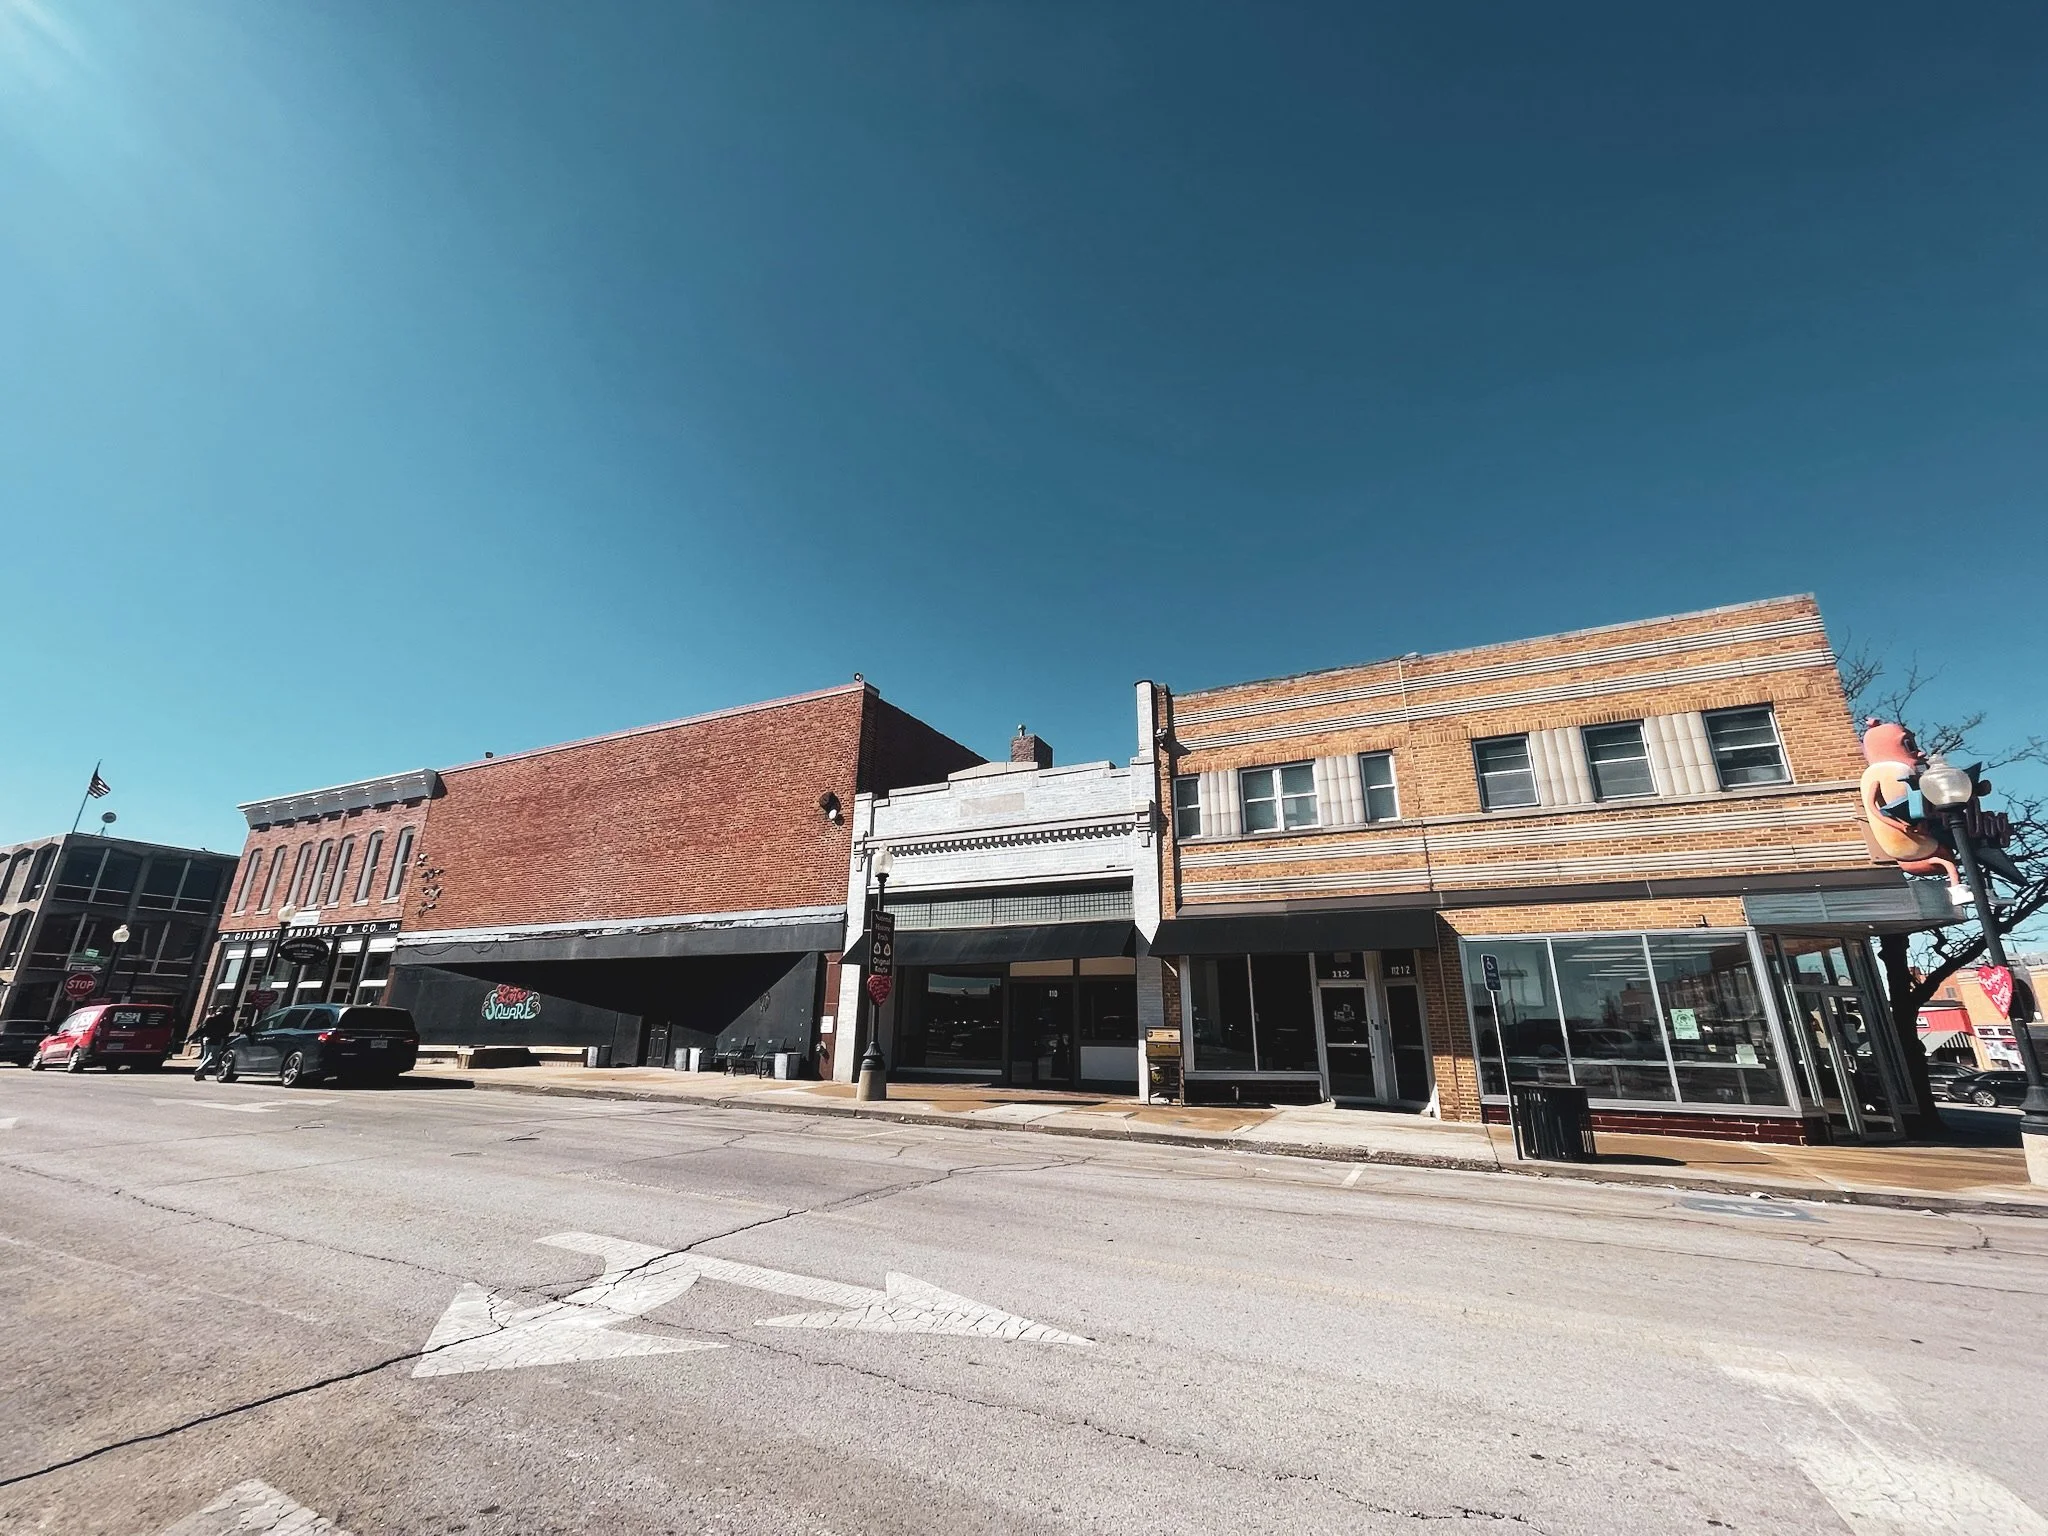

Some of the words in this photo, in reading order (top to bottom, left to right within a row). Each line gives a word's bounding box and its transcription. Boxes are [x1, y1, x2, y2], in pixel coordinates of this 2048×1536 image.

[234, 930, 279, 941] GILBERT
[287, 926, 337, 938] WHITNEY
[345, 925, 354, 933] &
[361, 924, 378, 933] CO.
[1332, 970, 1350, 978] 112
[67, 979, 95, 989] STOP
[1049, 989, 1058, 998] 110
[485, 993, 537, 1020] SQUARE
